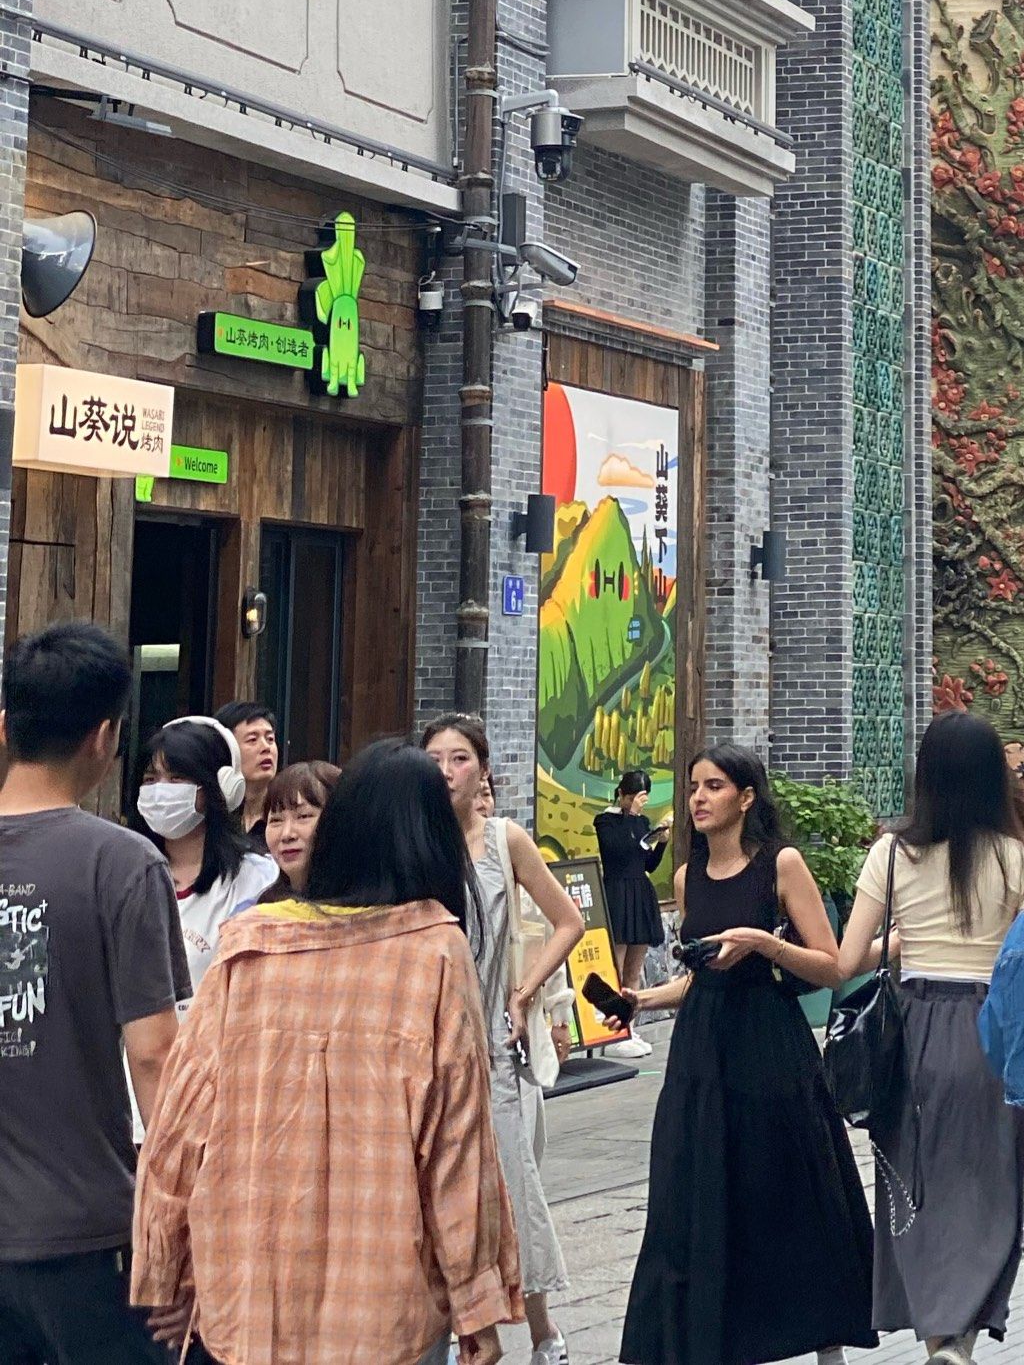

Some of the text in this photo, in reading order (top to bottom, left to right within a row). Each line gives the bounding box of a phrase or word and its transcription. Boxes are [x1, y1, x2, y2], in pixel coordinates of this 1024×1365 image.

[49, 393, 140, 451] 山葵说
[142, 407, 165, 422] WASABI
[142, 420, 165, 434] LEGEND
[140, 433, 164, 454] 烤肉
[184, 456, 218, 474] Welcome
[655, 443, 668, 603] 山葵下山
